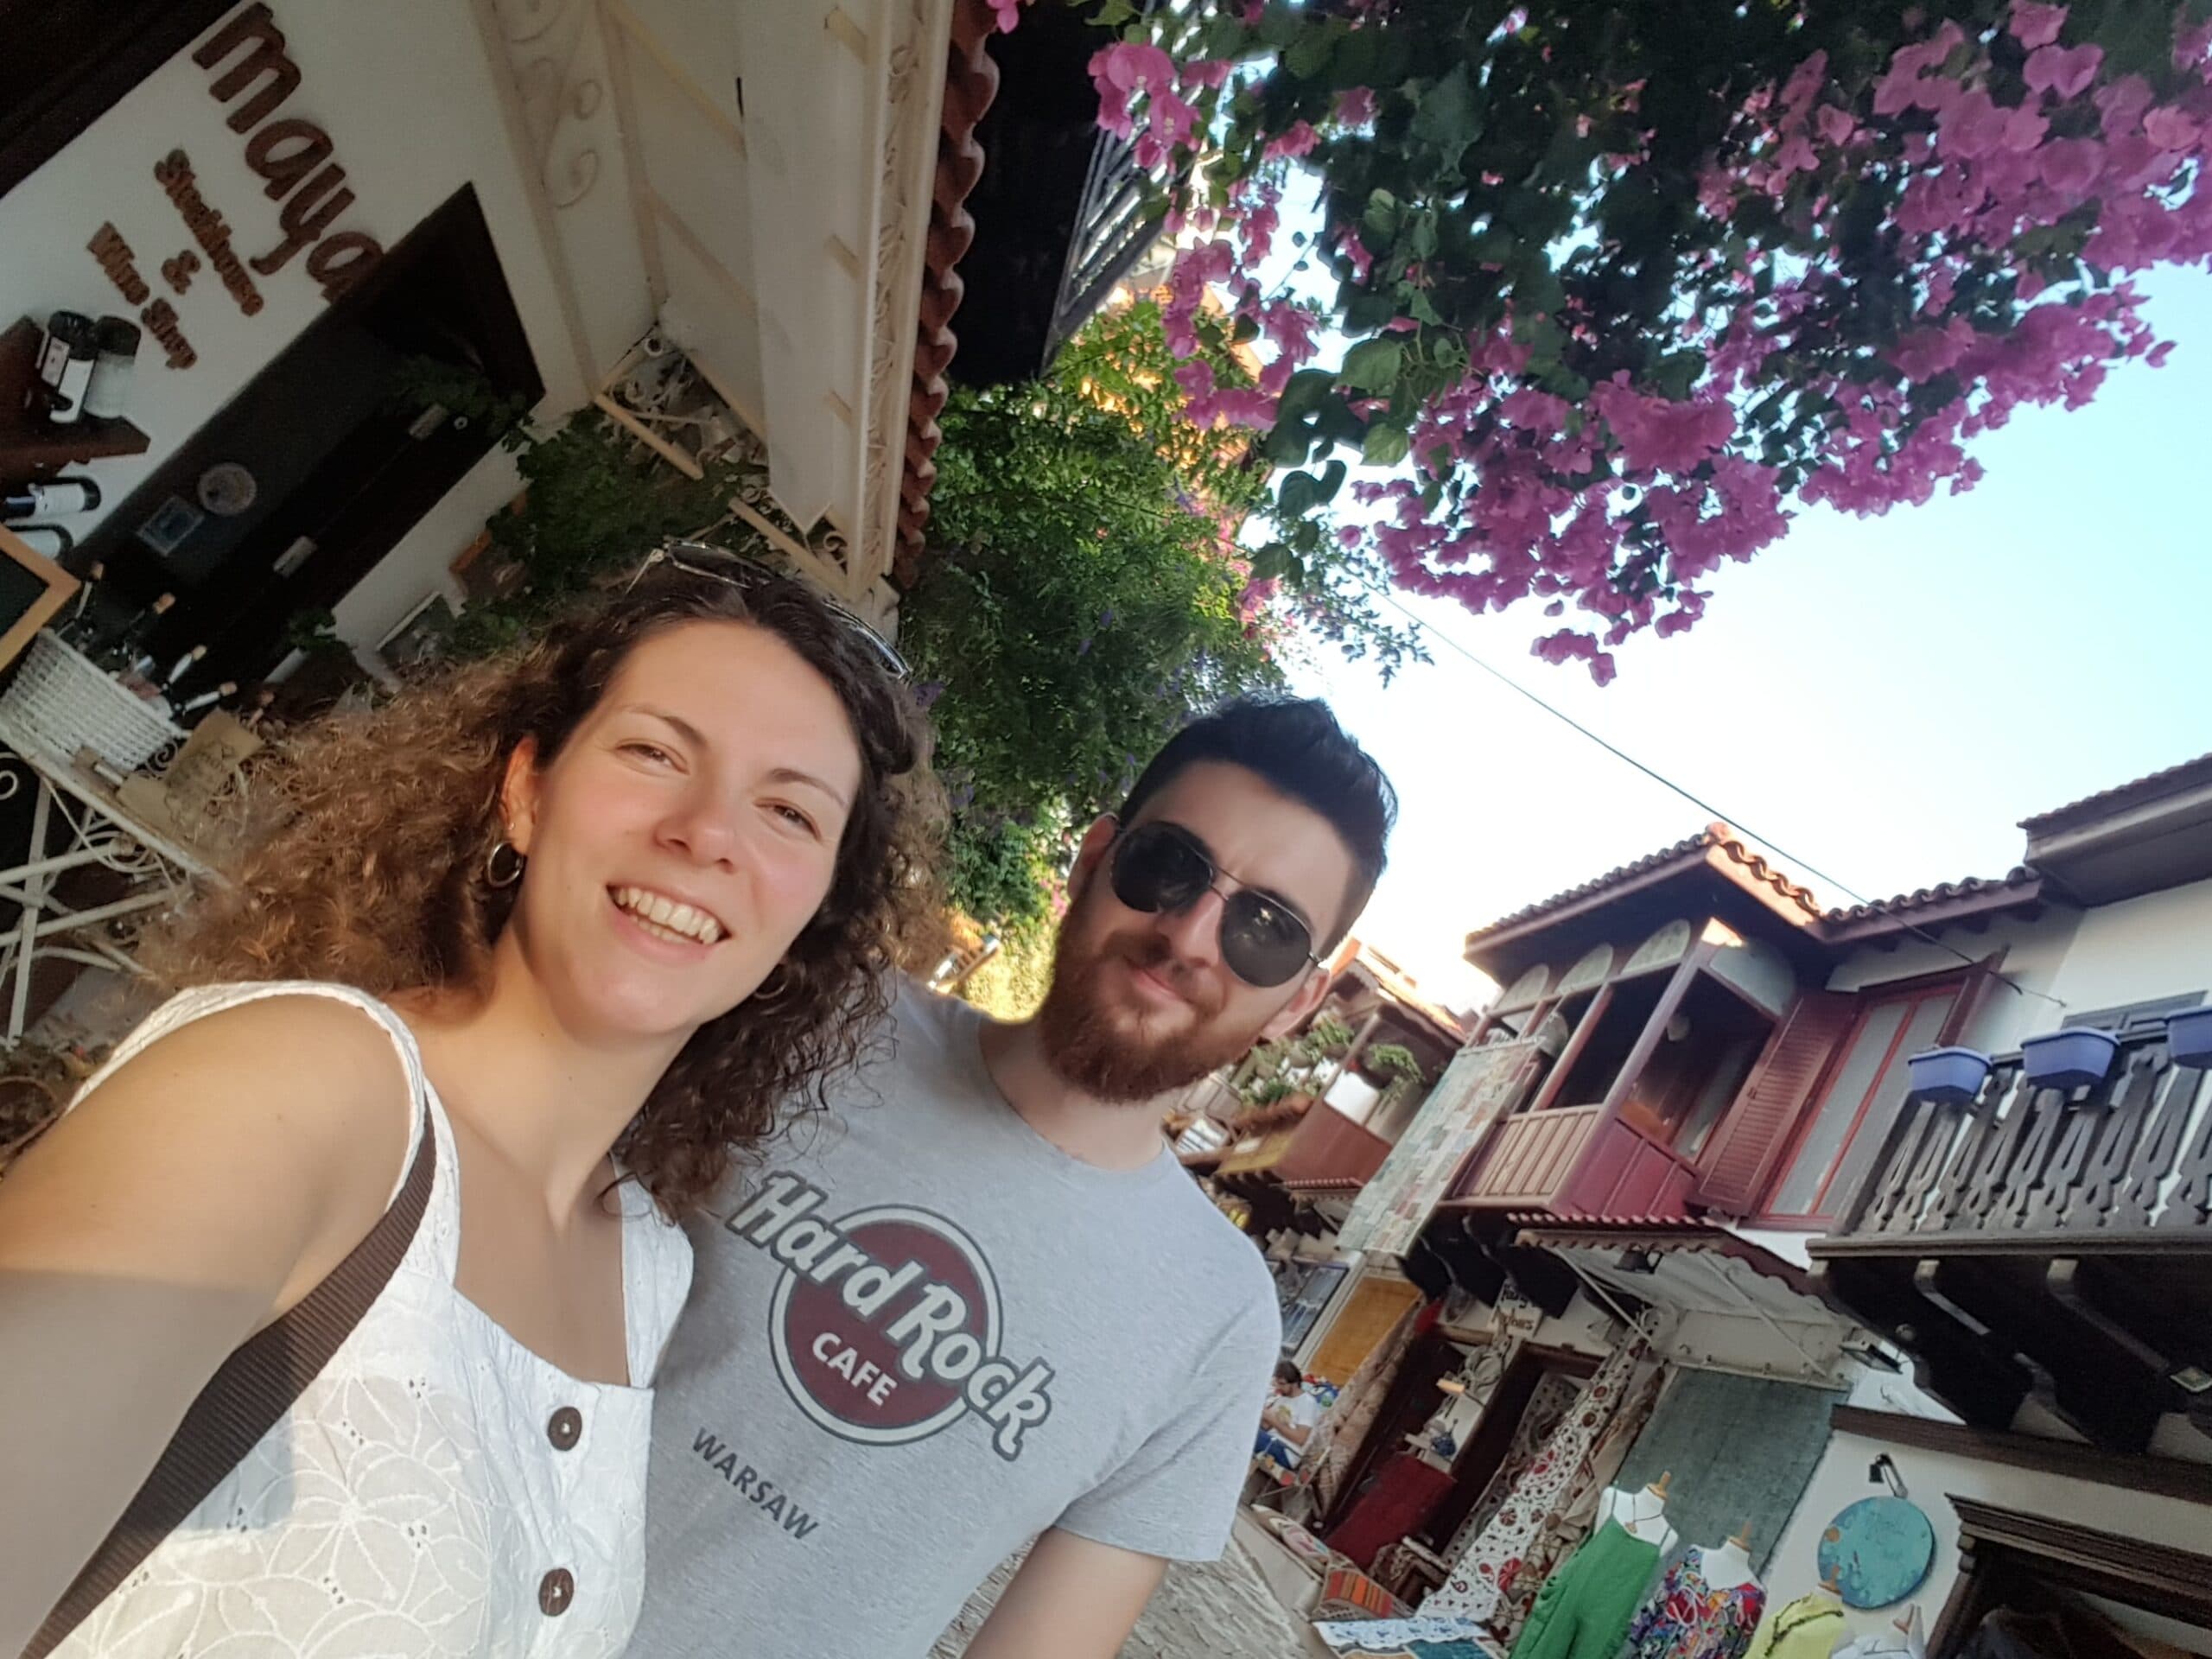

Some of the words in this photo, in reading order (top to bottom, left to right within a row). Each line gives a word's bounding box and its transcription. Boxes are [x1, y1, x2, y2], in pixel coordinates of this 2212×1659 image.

[192, 3, 385, 304] maya
[162, 250, 200, 295] &
[724, 1170, 926, 1319] Hard
[884, 1281, 1056, 1462] Rock
[812, 1332, 897, 1407] CAFE
[691, 1427, 820, 1540] WARSAW
